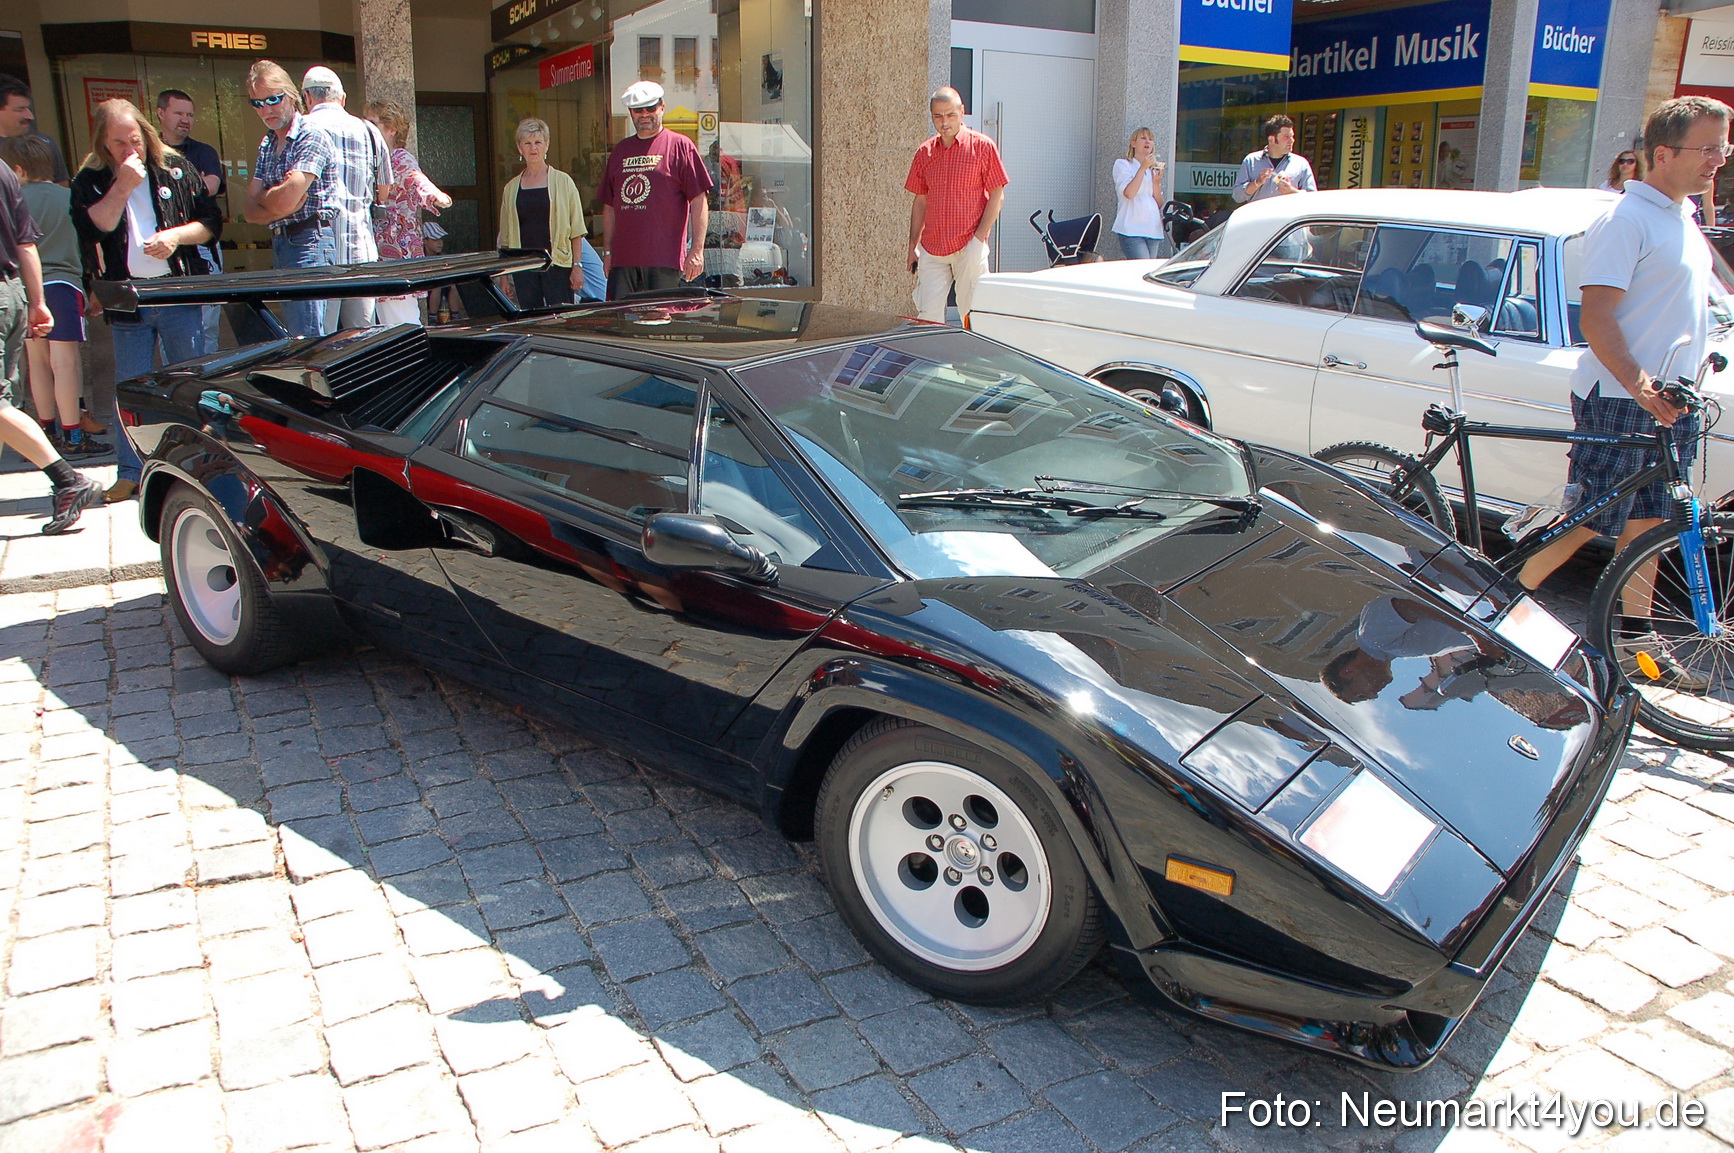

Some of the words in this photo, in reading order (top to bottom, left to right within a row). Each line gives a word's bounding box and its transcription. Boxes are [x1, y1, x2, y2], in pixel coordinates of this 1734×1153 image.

[191, 31, 267, 50] FRIES
[1395, 23, 1480, 66] Musik
[1542, 24, 1596, 54] Bücher
[550, 56, 591, 87] Summertime
[1347, 117, 1363, 189] Weltbild
[625, 182, 643, 196] 60
[1192, 170, 1237, 187] Weltbil
